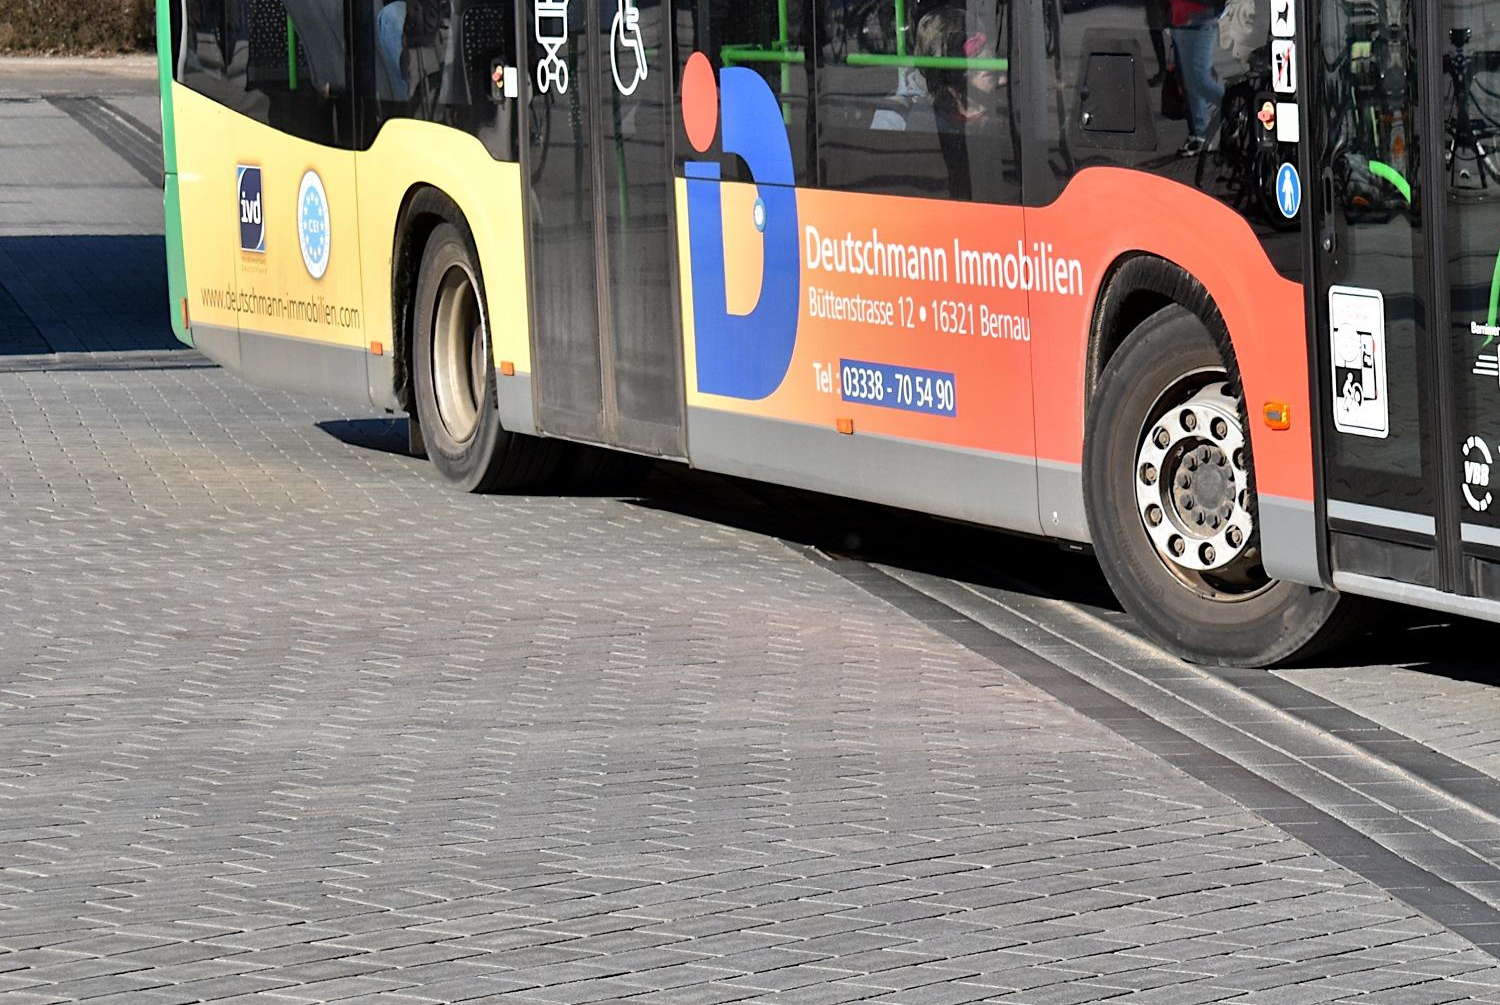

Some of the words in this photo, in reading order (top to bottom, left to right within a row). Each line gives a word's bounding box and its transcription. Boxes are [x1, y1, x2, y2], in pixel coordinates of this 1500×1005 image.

[240, 190, 262, 225] ivd
[805, 225, 948, 283] Deutschmann
[954, 238, 1084, 296] Immobilien
[200, 285, 361, 329] www.deutschmann-immobilien.com
[808, 286, 894, 326] Büttenstrasse
[898, 296, 915, 328] 12
[932, 300, 975, 335] 16321
[980, 305, 1031, 341] Bernau
[843, 366, 884, 401] 03338
[895, 373, 912, 404] 70
[916, 377, 933, 407] 54
[937, 380, 954, 411] 90
[1464, 460, 1490, 486] VBB
